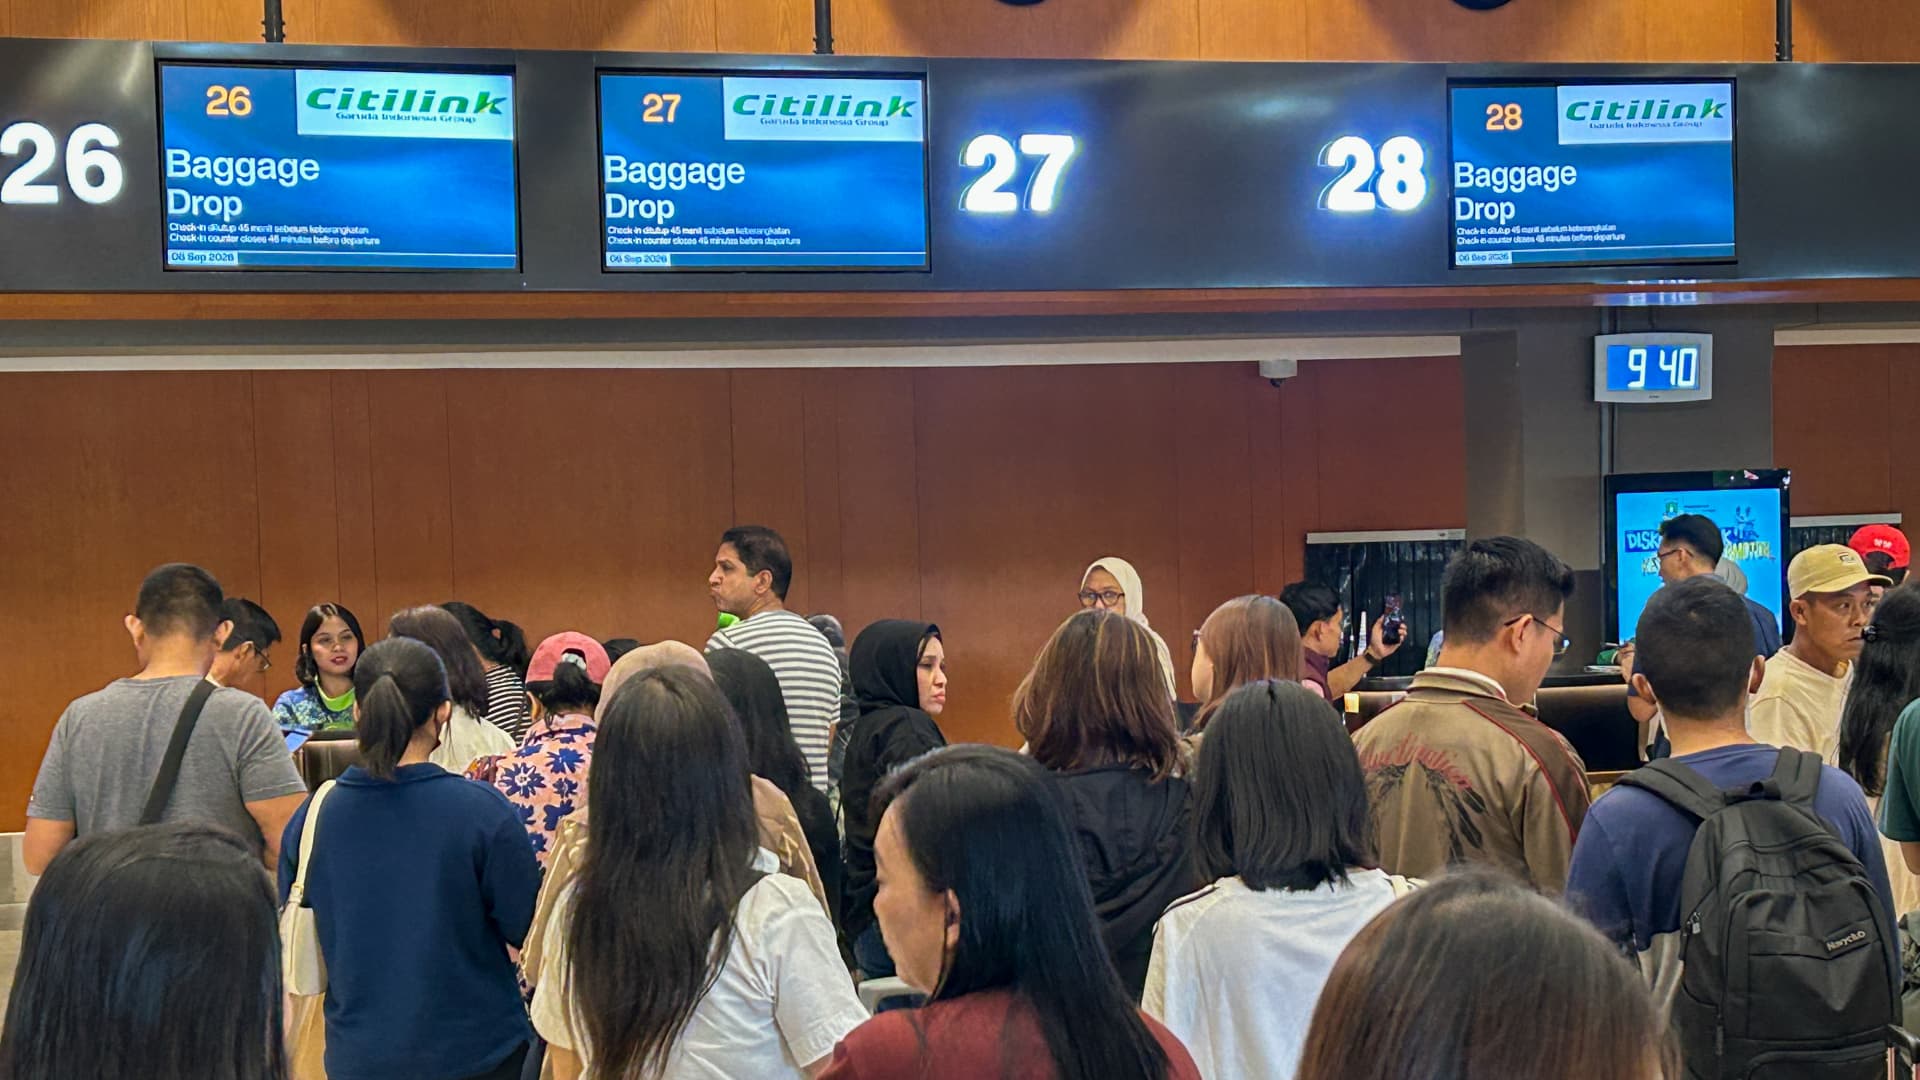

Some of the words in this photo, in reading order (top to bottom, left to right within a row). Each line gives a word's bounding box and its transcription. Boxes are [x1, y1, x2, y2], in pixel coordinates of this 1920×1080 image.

[205, 85, 252, 116] 26
[306, 87, 507, 115] Citilink
[642, 93, 682, 123] 27
[733, 94, 917, 118] Citilink
[1566, 98, 1728, 121] Citilink
[336, 112, 379, 121] Garuda
[382, 113, 437, 122] Indonesia
[440, 114, 476, 124] Group
[760, 117, 800, 126] Garuda
[802, 117, 853, 126] Indonesia
[856, 118, 889, 127] Group
[1486, 103, 1523, 132] 28
[0, 122, 123, 204] 26
[166, 148, 320, 187] Baggage
[604, 154, 745, 190] Baggage
[959, 134, 1076, 213] 27
[1318, 136, 1427, 211] 28
[1455, 161, 1577, 193] Baggage
[167, 188, 243, 222] Drop
[606, 194, 675, 224] Drop
[1456, 197, 1515, 224] Drop
[169, 222, 206, 232] Check-in
[169, 233, 207, 242] Check-in
[208, 234, 239, 243] counter
[607, 225, 642, 234] Check-in
[607, 236, 642, 245] Check-in
[643, 236, 671, 245] counter
[187, 252, 207, 264] Sep
[624, 254, 642, 264] Sep
[1627, 348, 1647, 388] 9
[1659, 348, 1698, 387] 40
[1626, 530, 1660, 550] DISK
